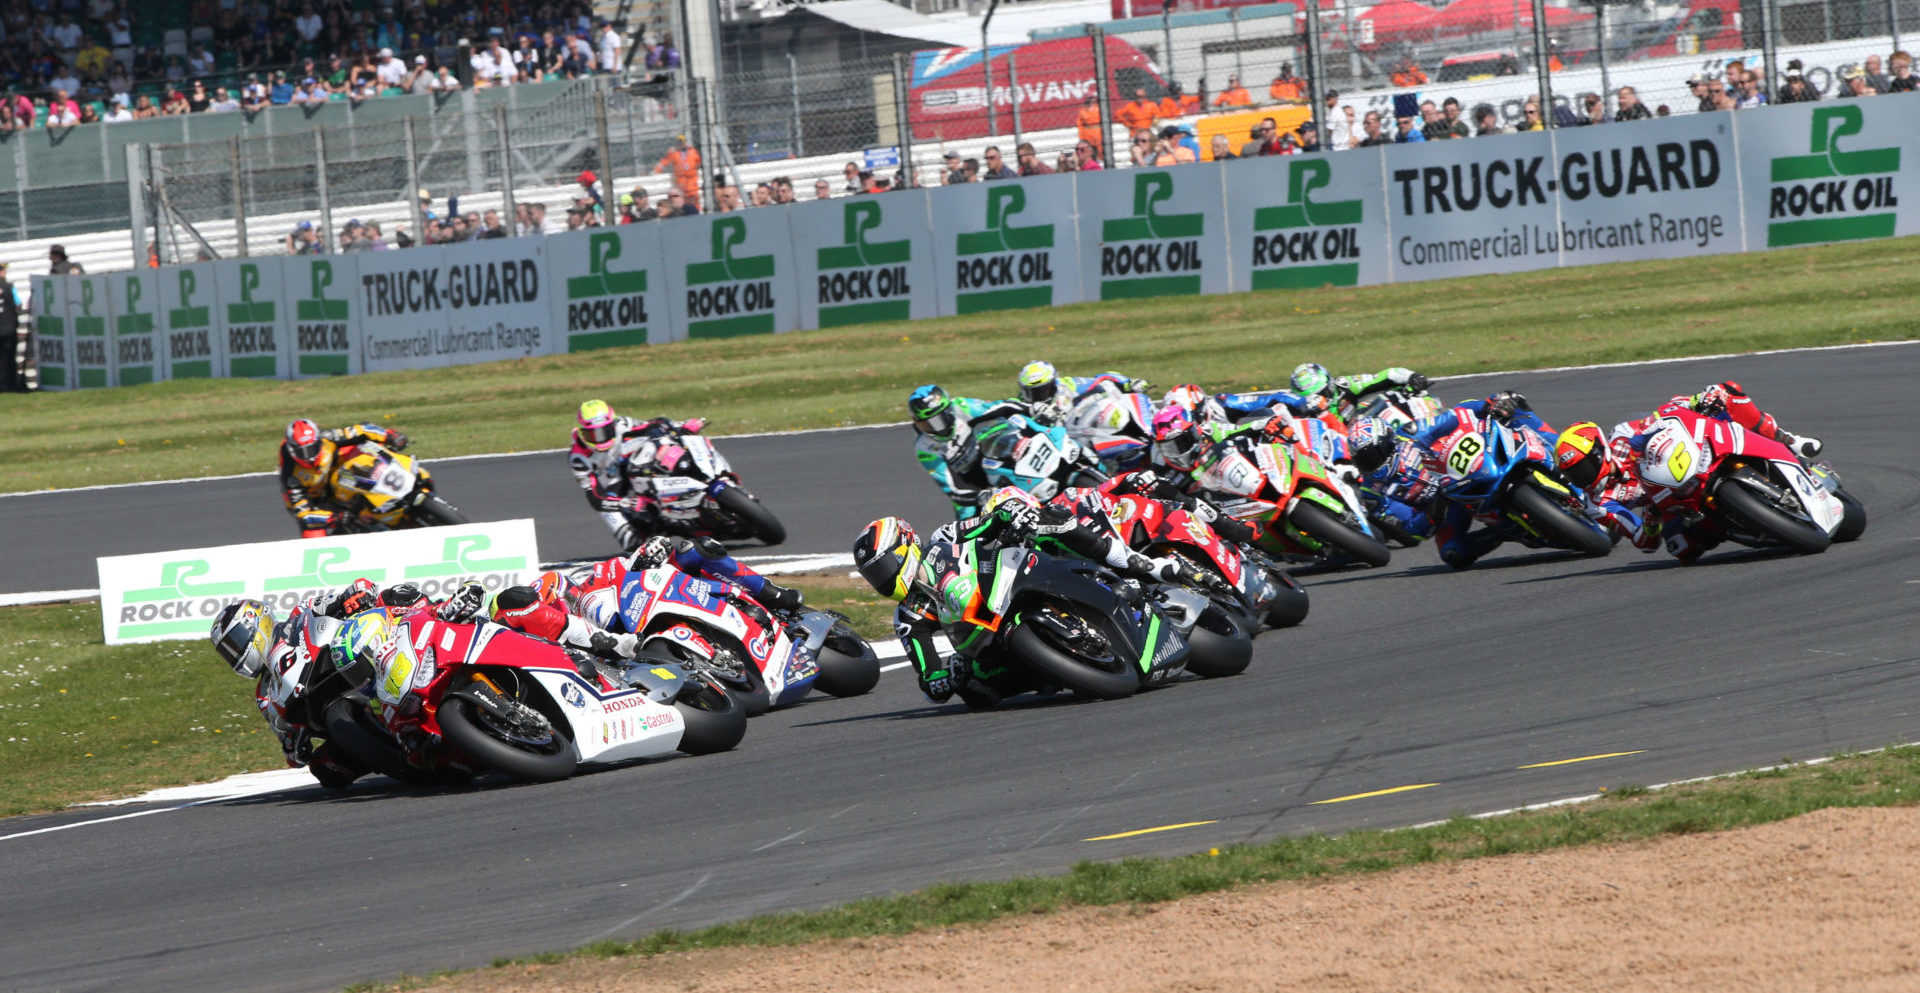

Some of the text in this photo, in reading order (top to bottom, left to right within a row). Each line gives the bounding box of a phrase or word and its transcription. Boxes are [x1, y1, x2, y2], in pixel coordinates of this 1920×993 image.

[1394, 138, 1721, 216] TRUCK-GUARD
[1769, 176, 1898, 219] ROCK OIL
[1253, 227, 1360, 266] ROCK OIL
[1399, 212, 1723, 265] Commercial Lubricant Range
[957, 252, 1052, 289] ROCK OIL
[1101, 240, 1202, 276] ROCK OIL
[362, 258, 539, 317] TRUCK-GUARD
[687, 281, 775, 319] ROCK OIL
[818, 266, 911, 304] ROCK OIL
[568, 296, 648, 332] ROCK OIL
[229, 325, 276, 354] ROCK OIL
[298, 323, 349, 351] ROCK OIL
[367, 322, 541, 361] Commercial Lubricant Range
[1029, 442, 1053, 473] 23
[1449, 436, 1481, 476] 28
[1668, 441, 1692, 483] 6
[120, 600, 196, 624] ROCK
[602, 696, 646, 714] HONDA
[645, 711, 674, 729] Castrol
